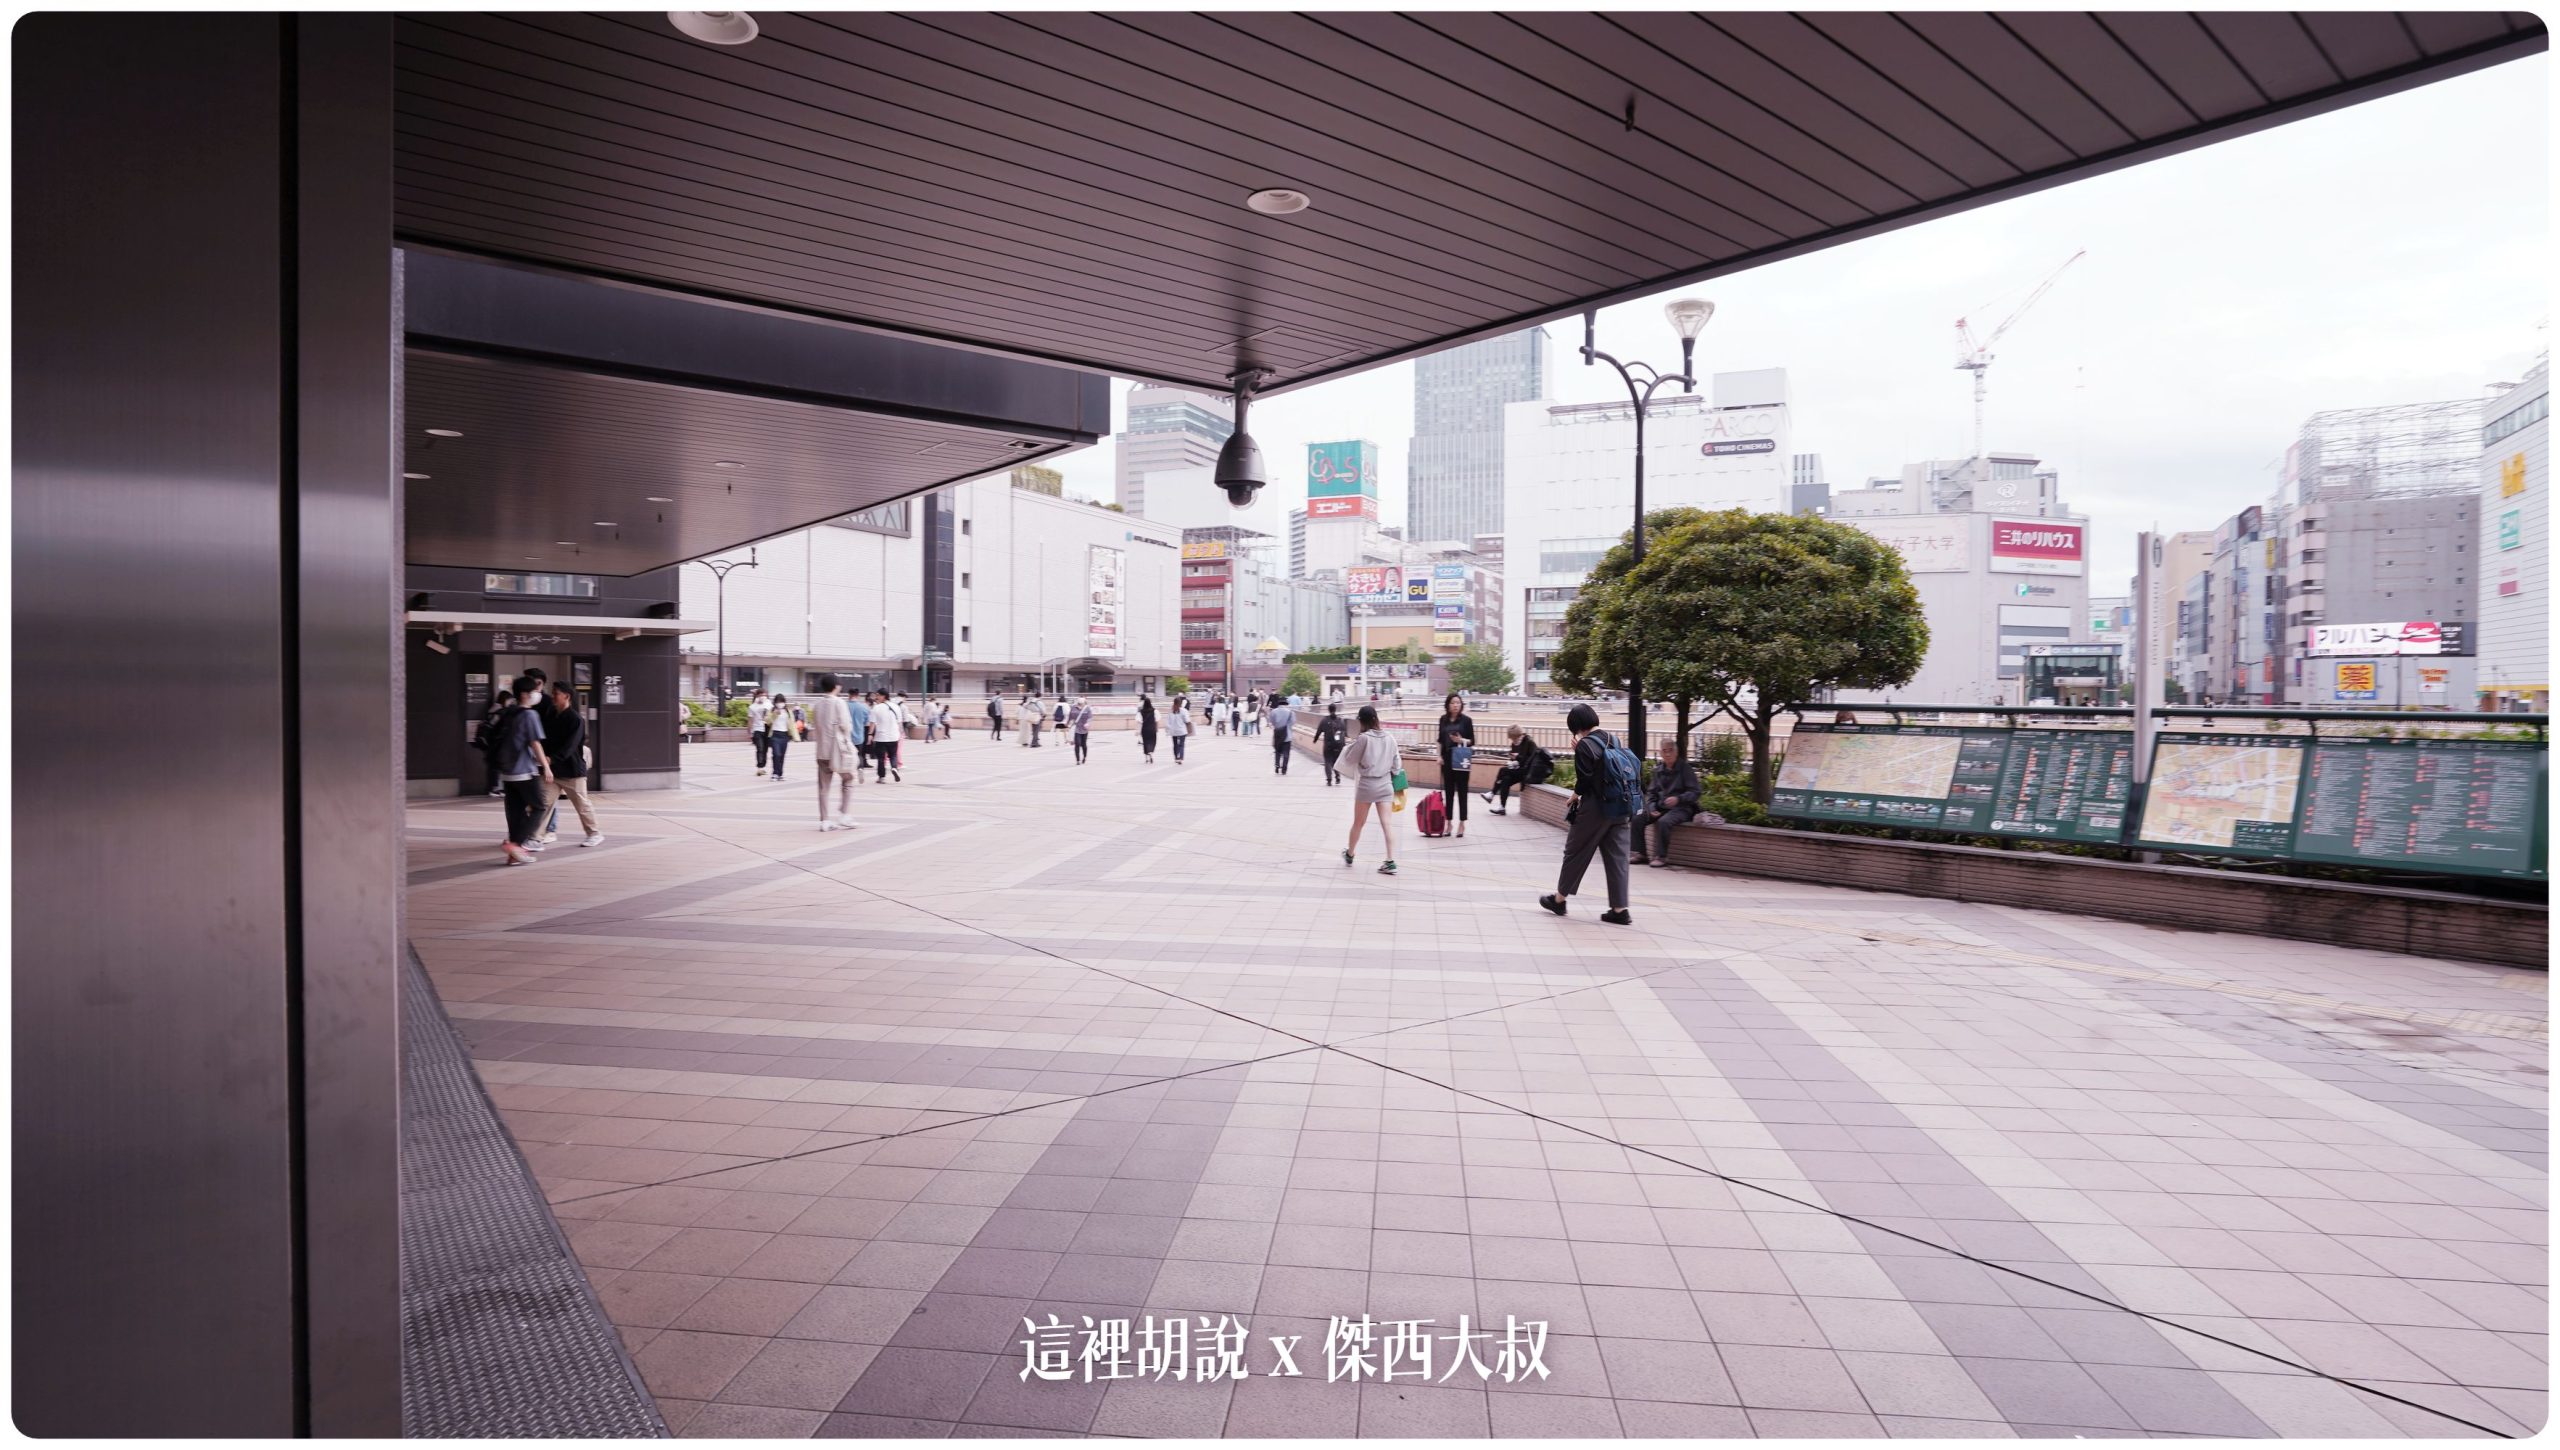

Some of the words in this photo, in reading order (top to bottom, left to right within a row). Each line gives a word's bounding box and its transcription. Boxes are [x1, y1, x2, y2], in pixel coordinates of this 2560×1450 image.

[1713, 444, 1737, 453] TOHO
[1737, 442, 1774, 451] CINEMAS
[2000, 529, 2075, 549] 三井のリハウス
[1348, 573, 1381, 583] 大きい
[1348, 583, 1381, 592] サイズ
[1408, 585, 1428, 596] GU
[513, 635, 571, 645] エレベーター
[604, 675, 621, 685] 2F
[2340, 665, 2371, 690] 薬
